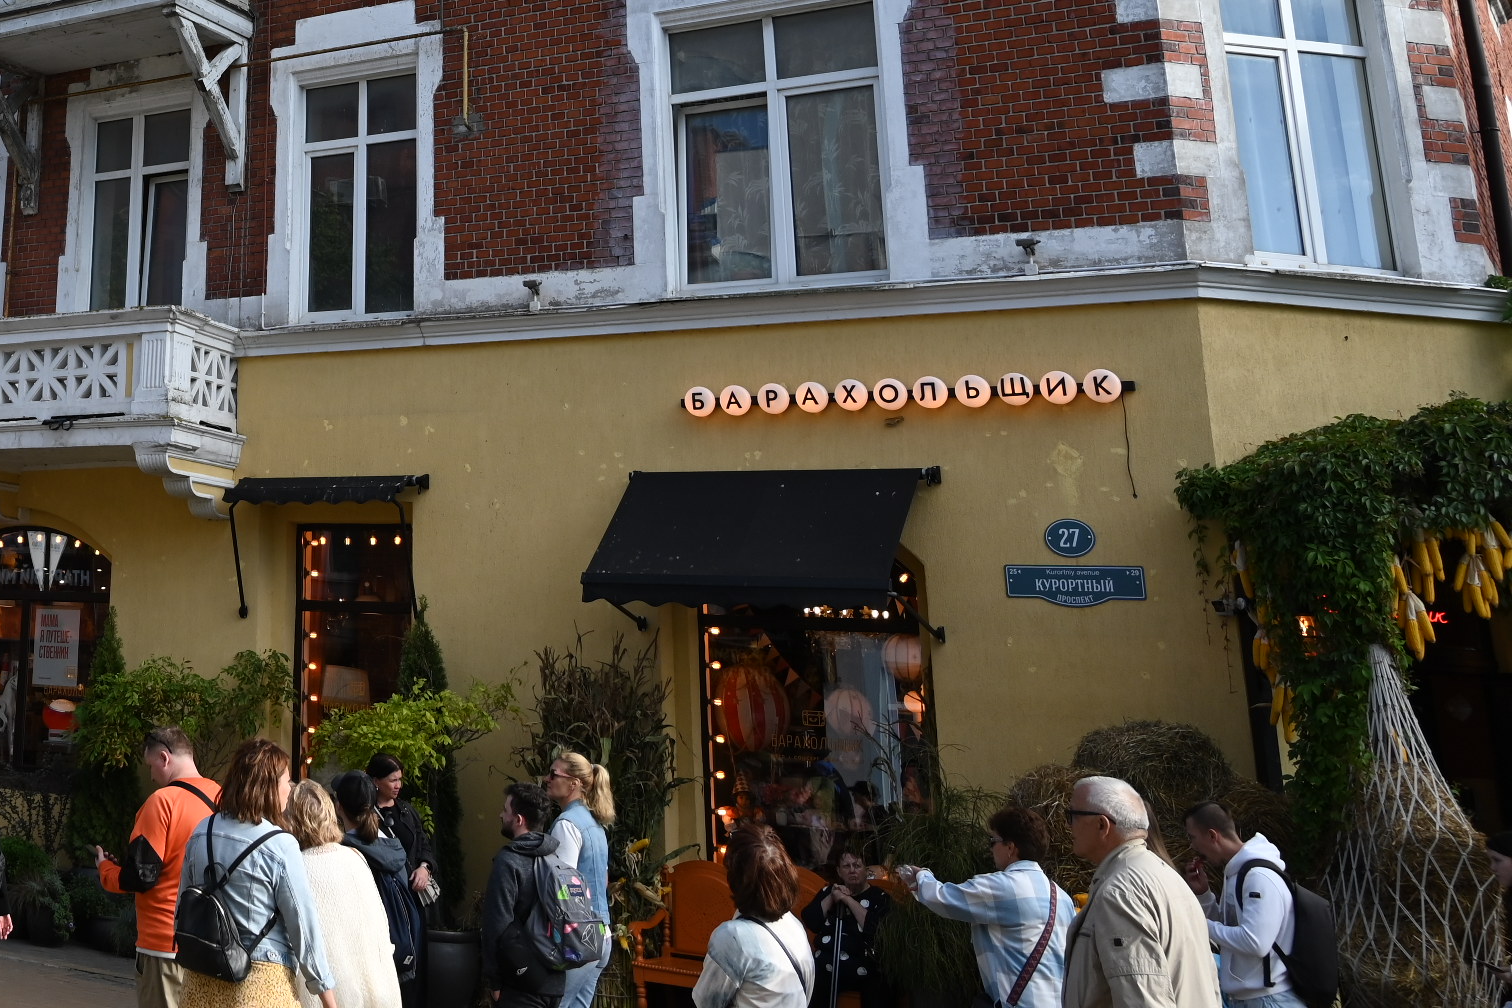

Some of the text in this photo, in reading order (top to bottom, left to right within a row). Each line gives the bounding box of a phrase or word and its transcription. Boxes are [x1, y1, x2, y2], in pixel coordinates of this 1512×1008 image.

[691, 374, 1113, 411] БАРАХОЛЬЩИК
[1058, 528, 1080, 548] 27
[1045, 568, 1075, 576] Kurortniy
[1035, 577, 1114, 592] КУРОРТНЫЙ
[1056, 594, 1094, 604] ПРОСПЕКТ
[40, 613, 59, 628] МАМА
[39, 629, 45, 643] Я
[38, 645, 70, 659] СТВЕННИК
